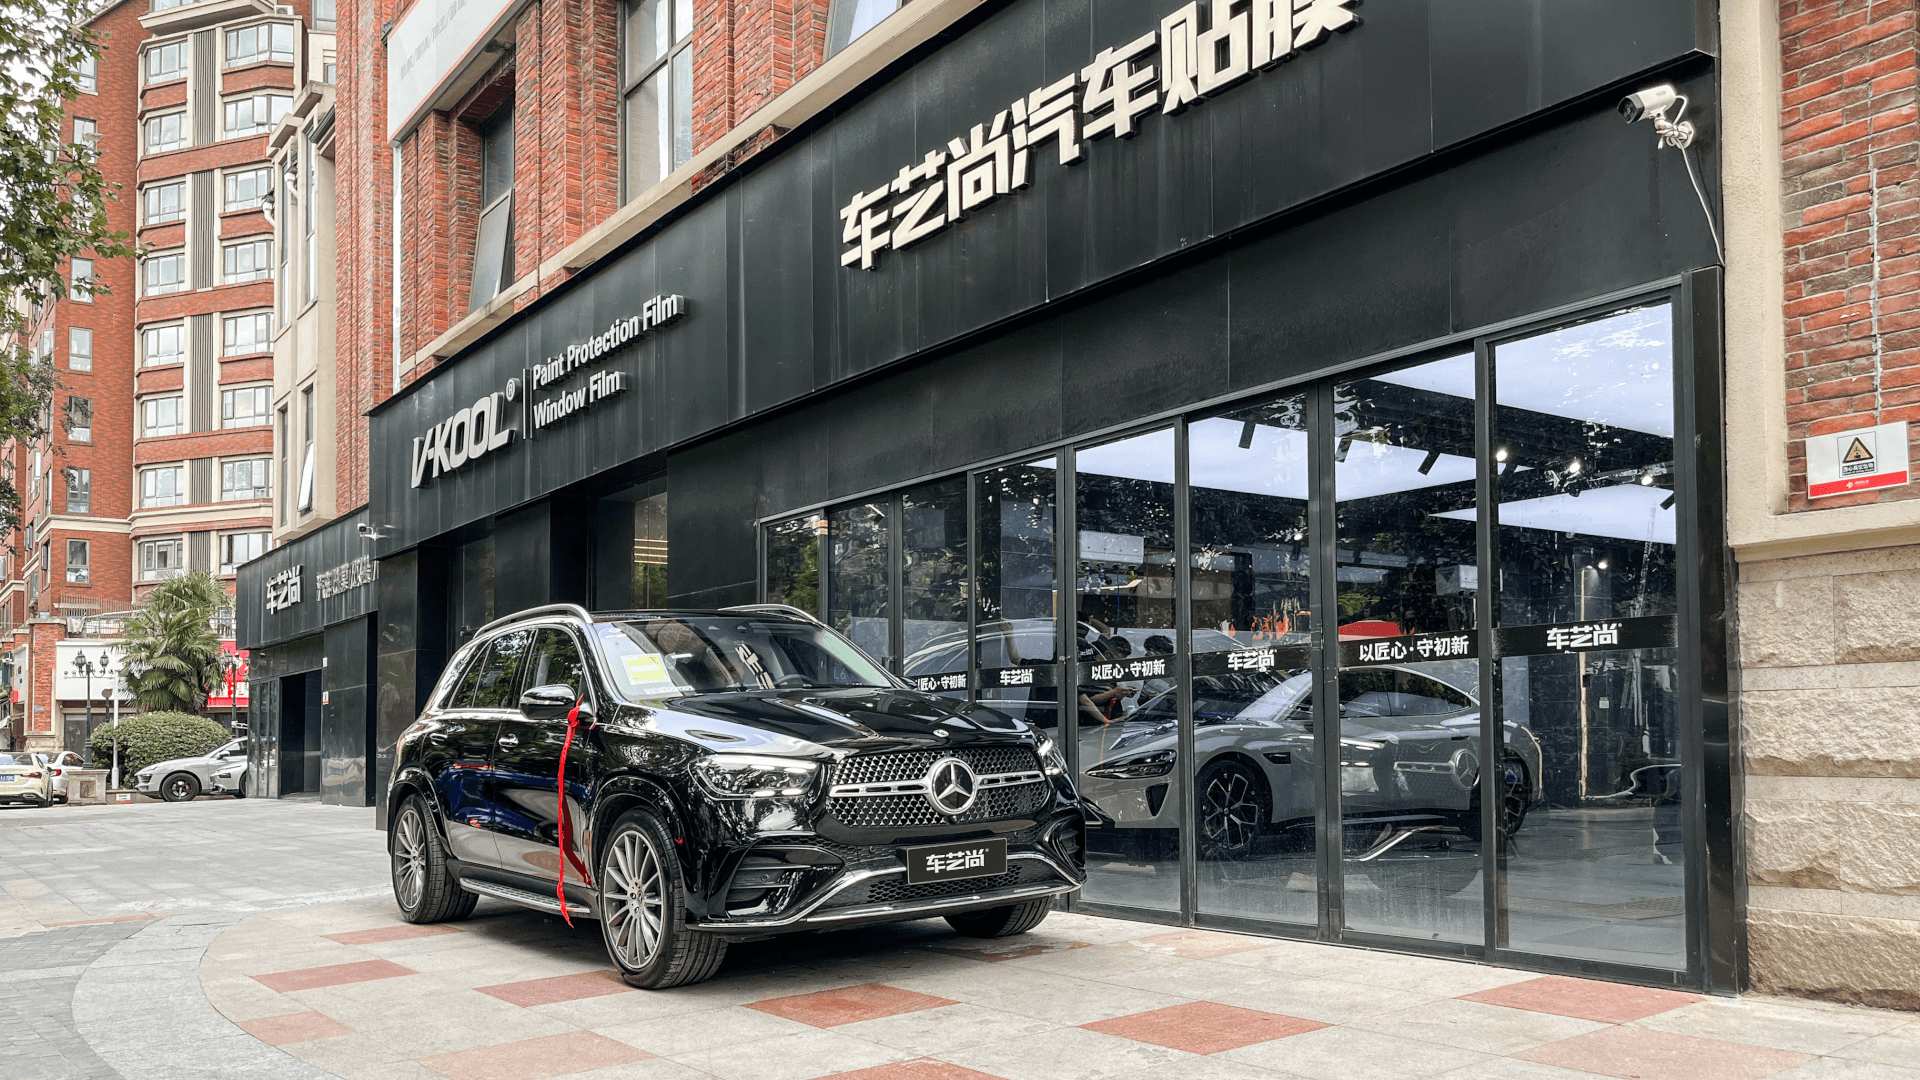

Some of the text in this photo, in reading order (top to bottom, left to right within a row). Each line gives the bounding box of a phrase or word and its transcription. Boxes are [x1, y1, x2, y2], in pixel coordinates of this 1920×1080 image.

[532, 294, 679, 391] Paint Protection Film
[533, 370, 621, 430] Window Film
[266, 565, 301, 615] 车艺尚
[1359, 635, 1470, 662] 以匠心·守初新
[1546, 622, 1619, 650] 车艺尚
[1091, 658, 1166, 681] 以匠心·守初新
[1227, 648, 1275, 671] 车艺尚
[1000, 668, 1033, 686] 车艺尚
[925, 848, 985, 874] 车艺尚
